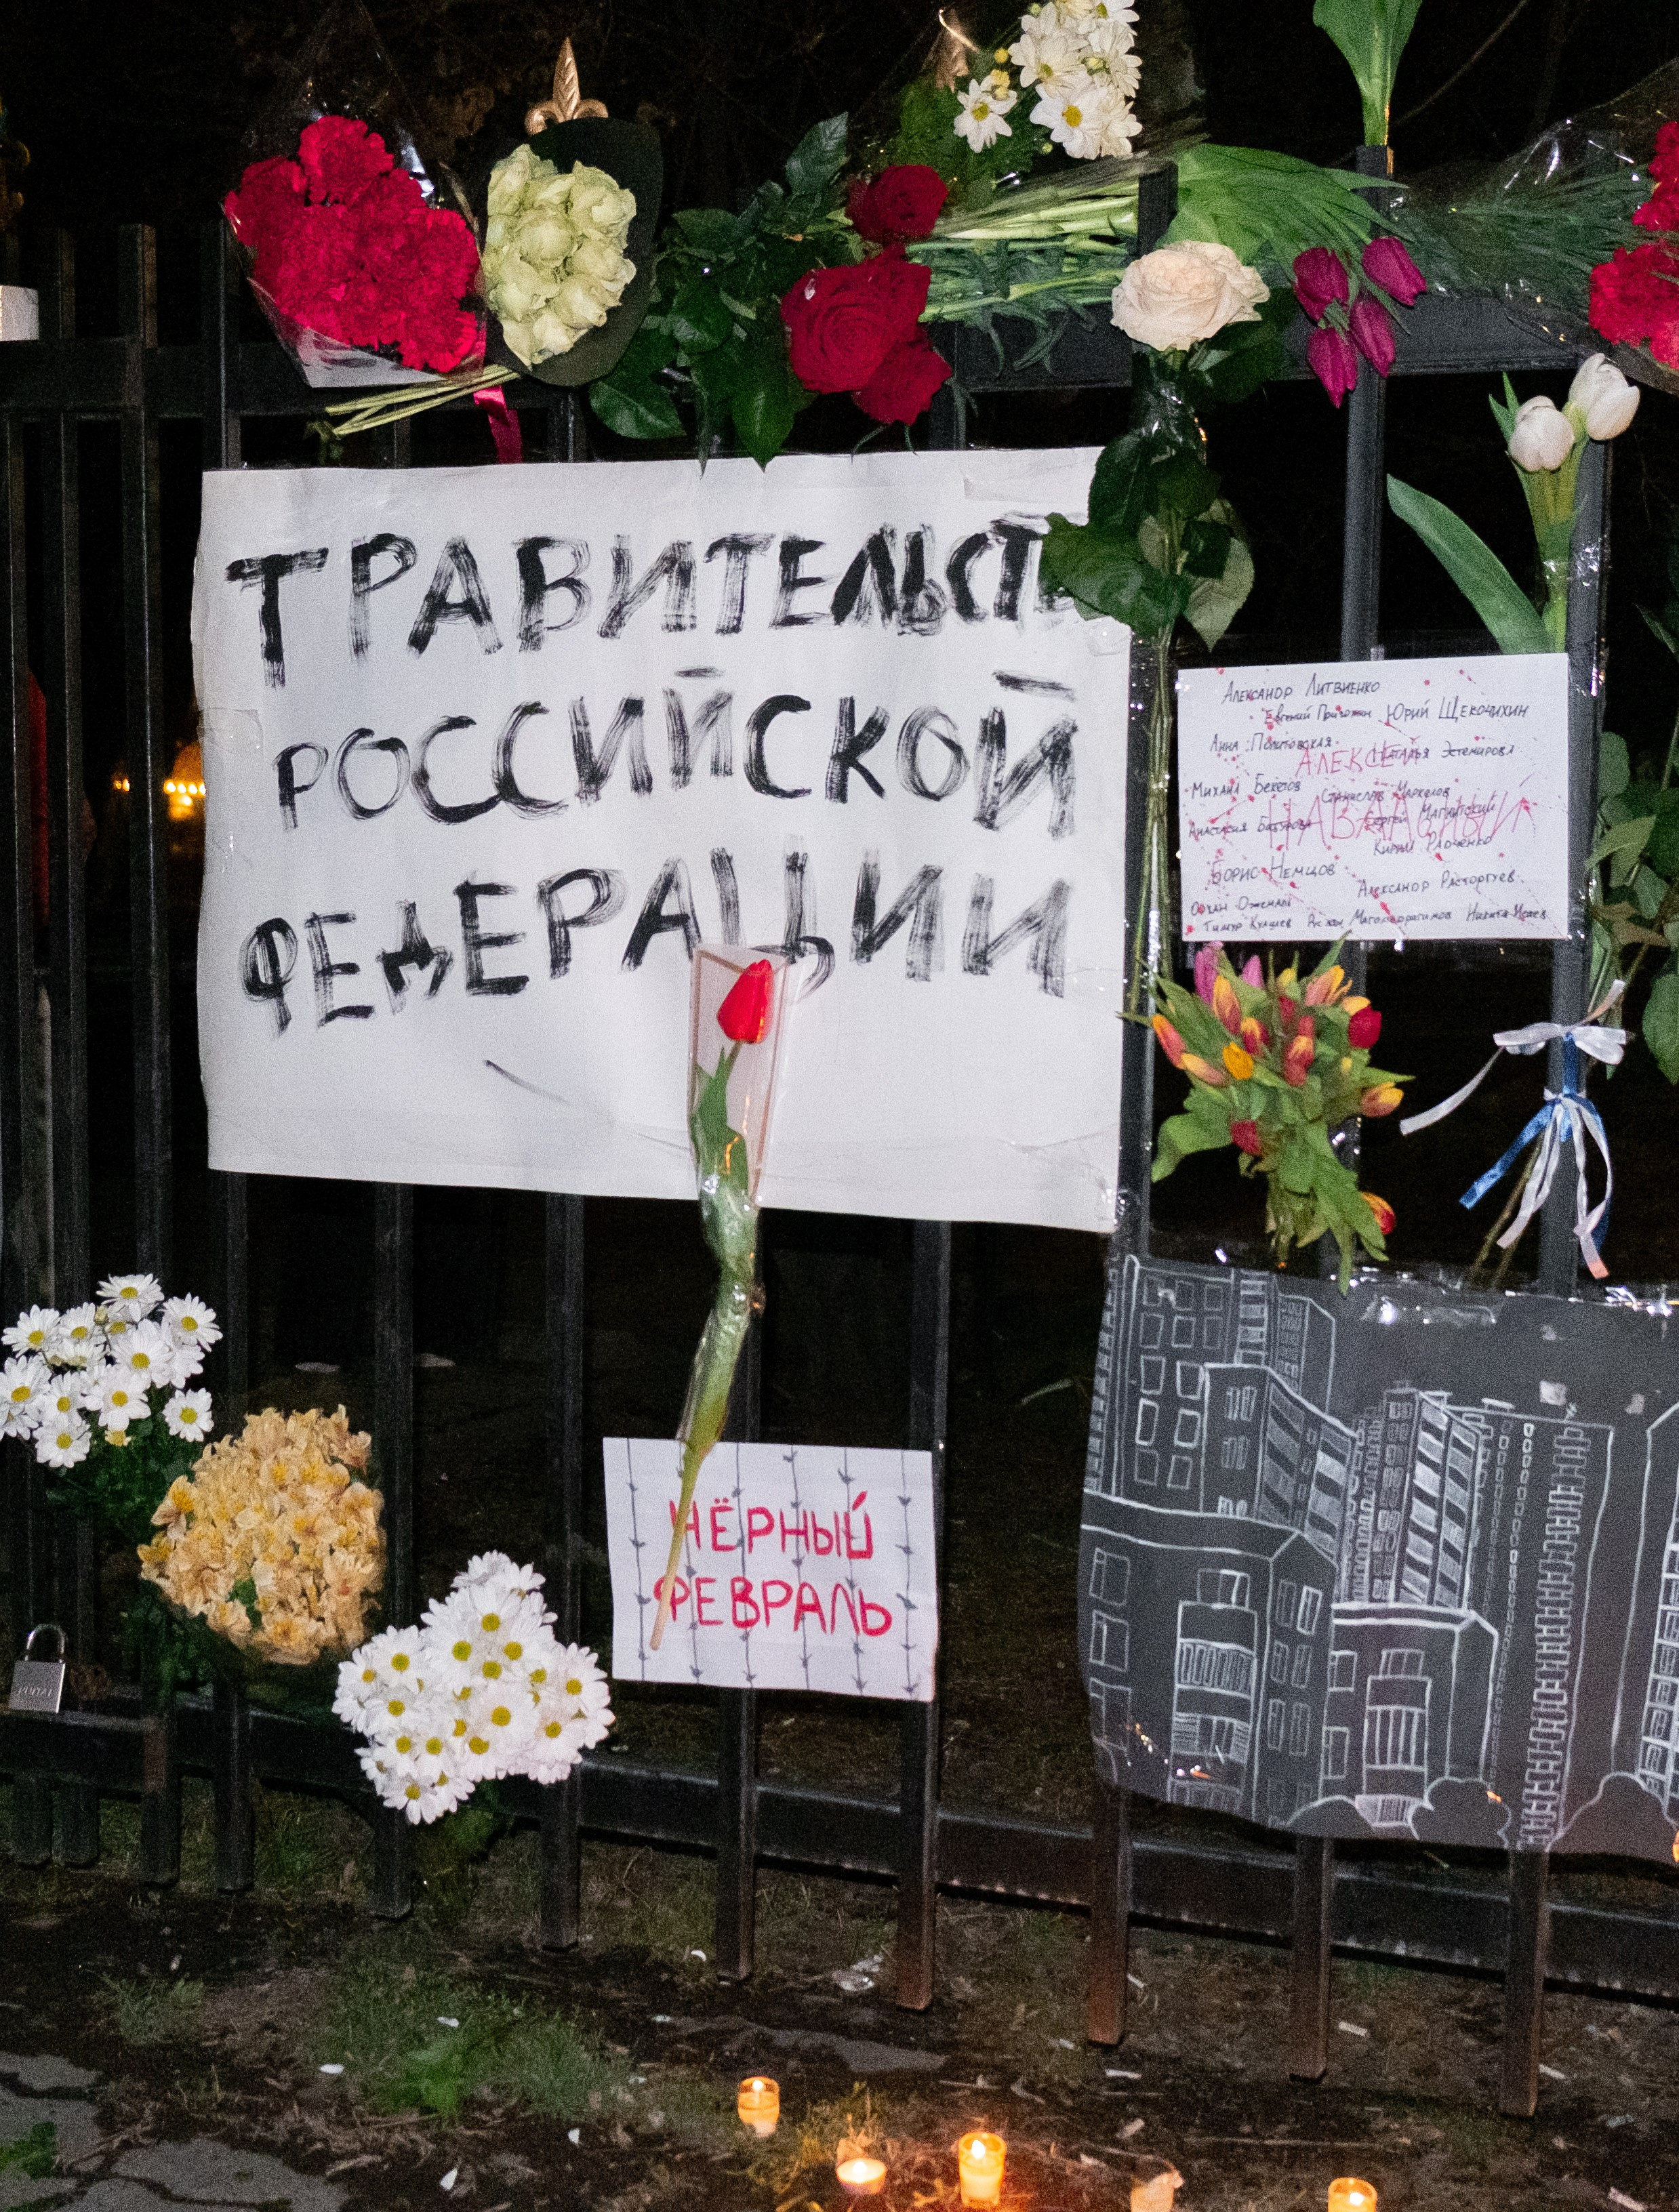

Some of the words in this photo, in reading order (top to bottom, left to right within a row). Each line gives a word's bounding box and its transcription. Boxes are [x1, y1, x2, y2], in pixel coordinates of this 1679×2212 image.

[225, 511, 1078, 688] ТРАВИТЕЛЬСТ
[276, 666, 1079, 839] РОССИЙСКОЙ
[241, 834, 1071, 1037] ФЕДЕРАЦИИ
[653, 1576, 893, 1637] ФЕВРАЛЬ
